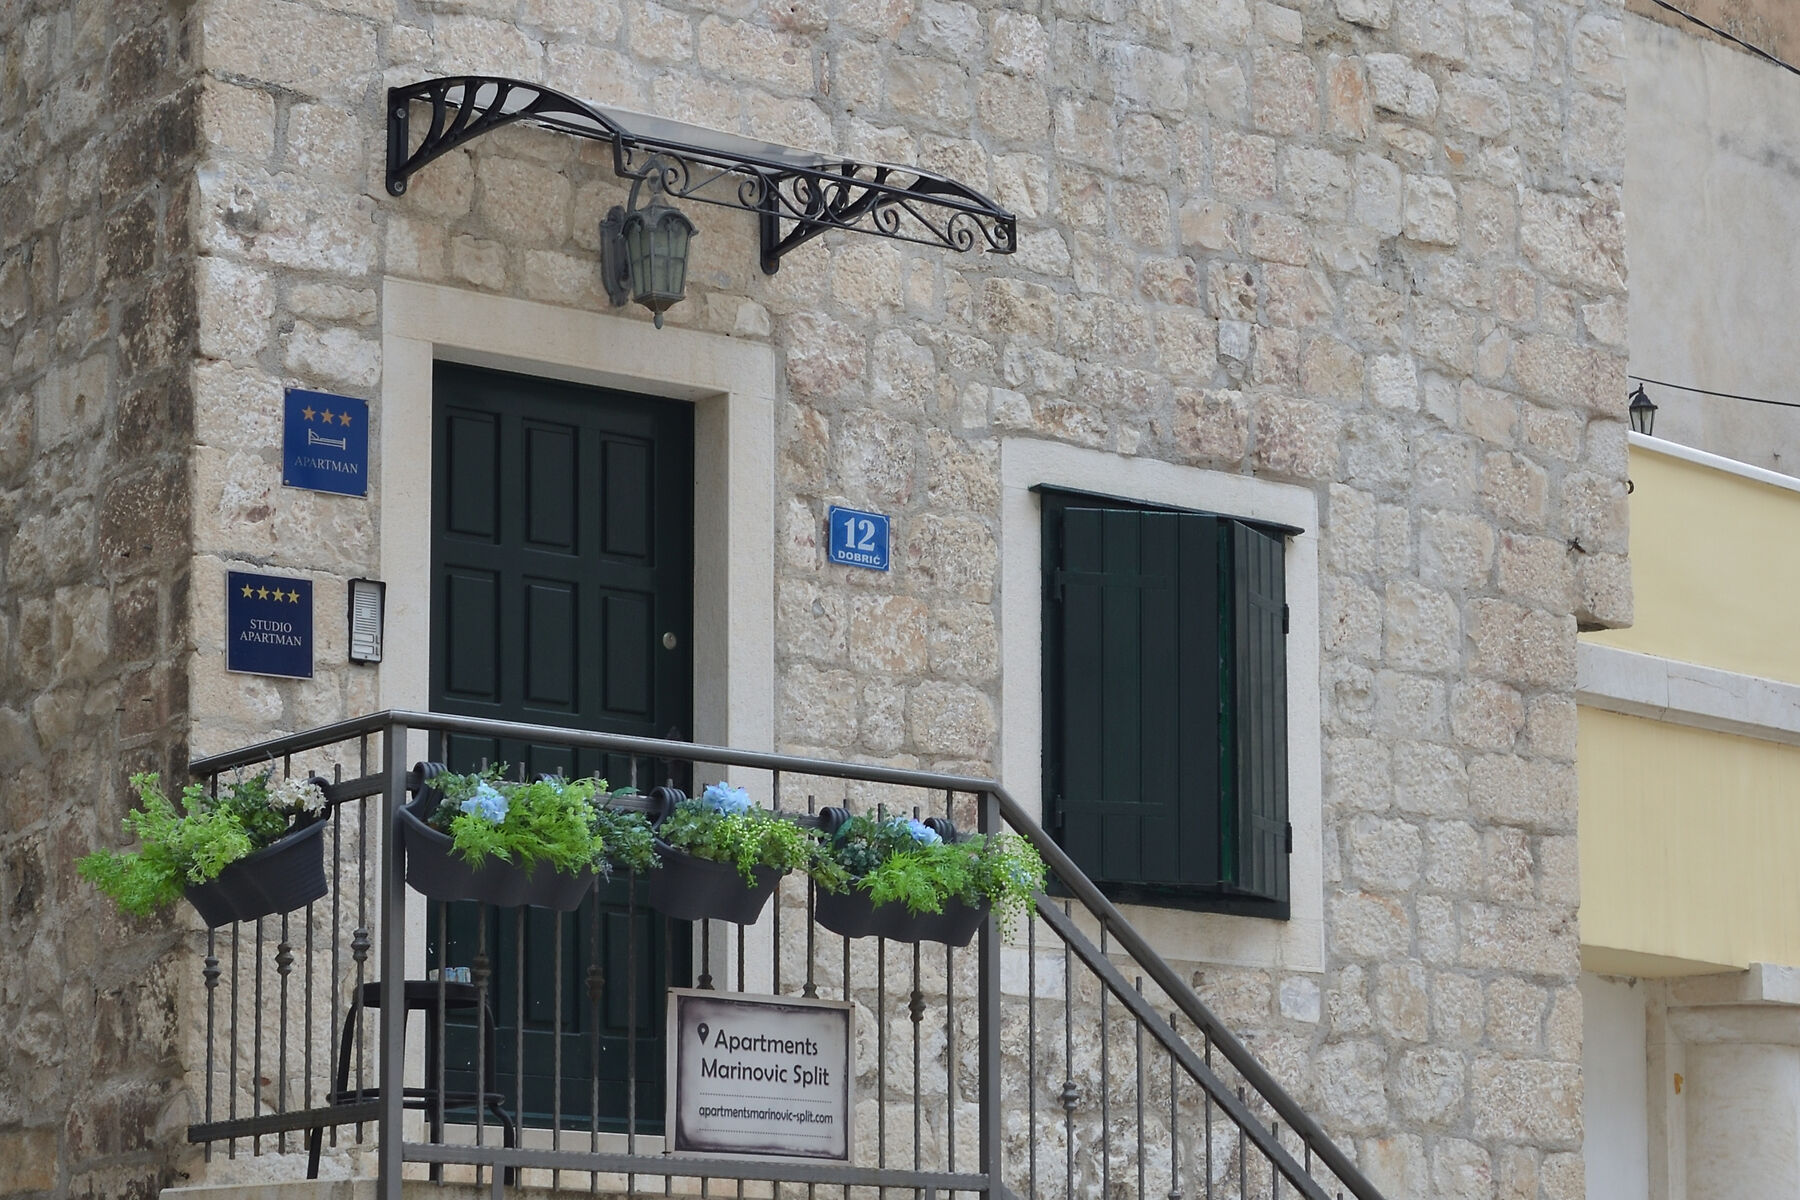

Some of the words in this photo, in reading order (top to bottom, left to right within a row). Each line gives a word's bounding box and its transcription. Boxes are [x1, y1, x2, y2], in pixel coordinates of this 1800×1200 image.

[294, 456, 359, 475] APARTMAN
[844, 517, 876, 552] 12
[837, 550, 881, 565] DOBRIĆ
[250, 618, 293, 634] STUDIO
[240, 631, 302, 647] APARTMAN
[714, 1029, 819, 1056] Apartments
[701, 1058, 788, 1083] Marinovic
[793, 1064, 830, 1089] Split
[698, 1104, 834, 1125] apartmentsmarinovic-split.com
